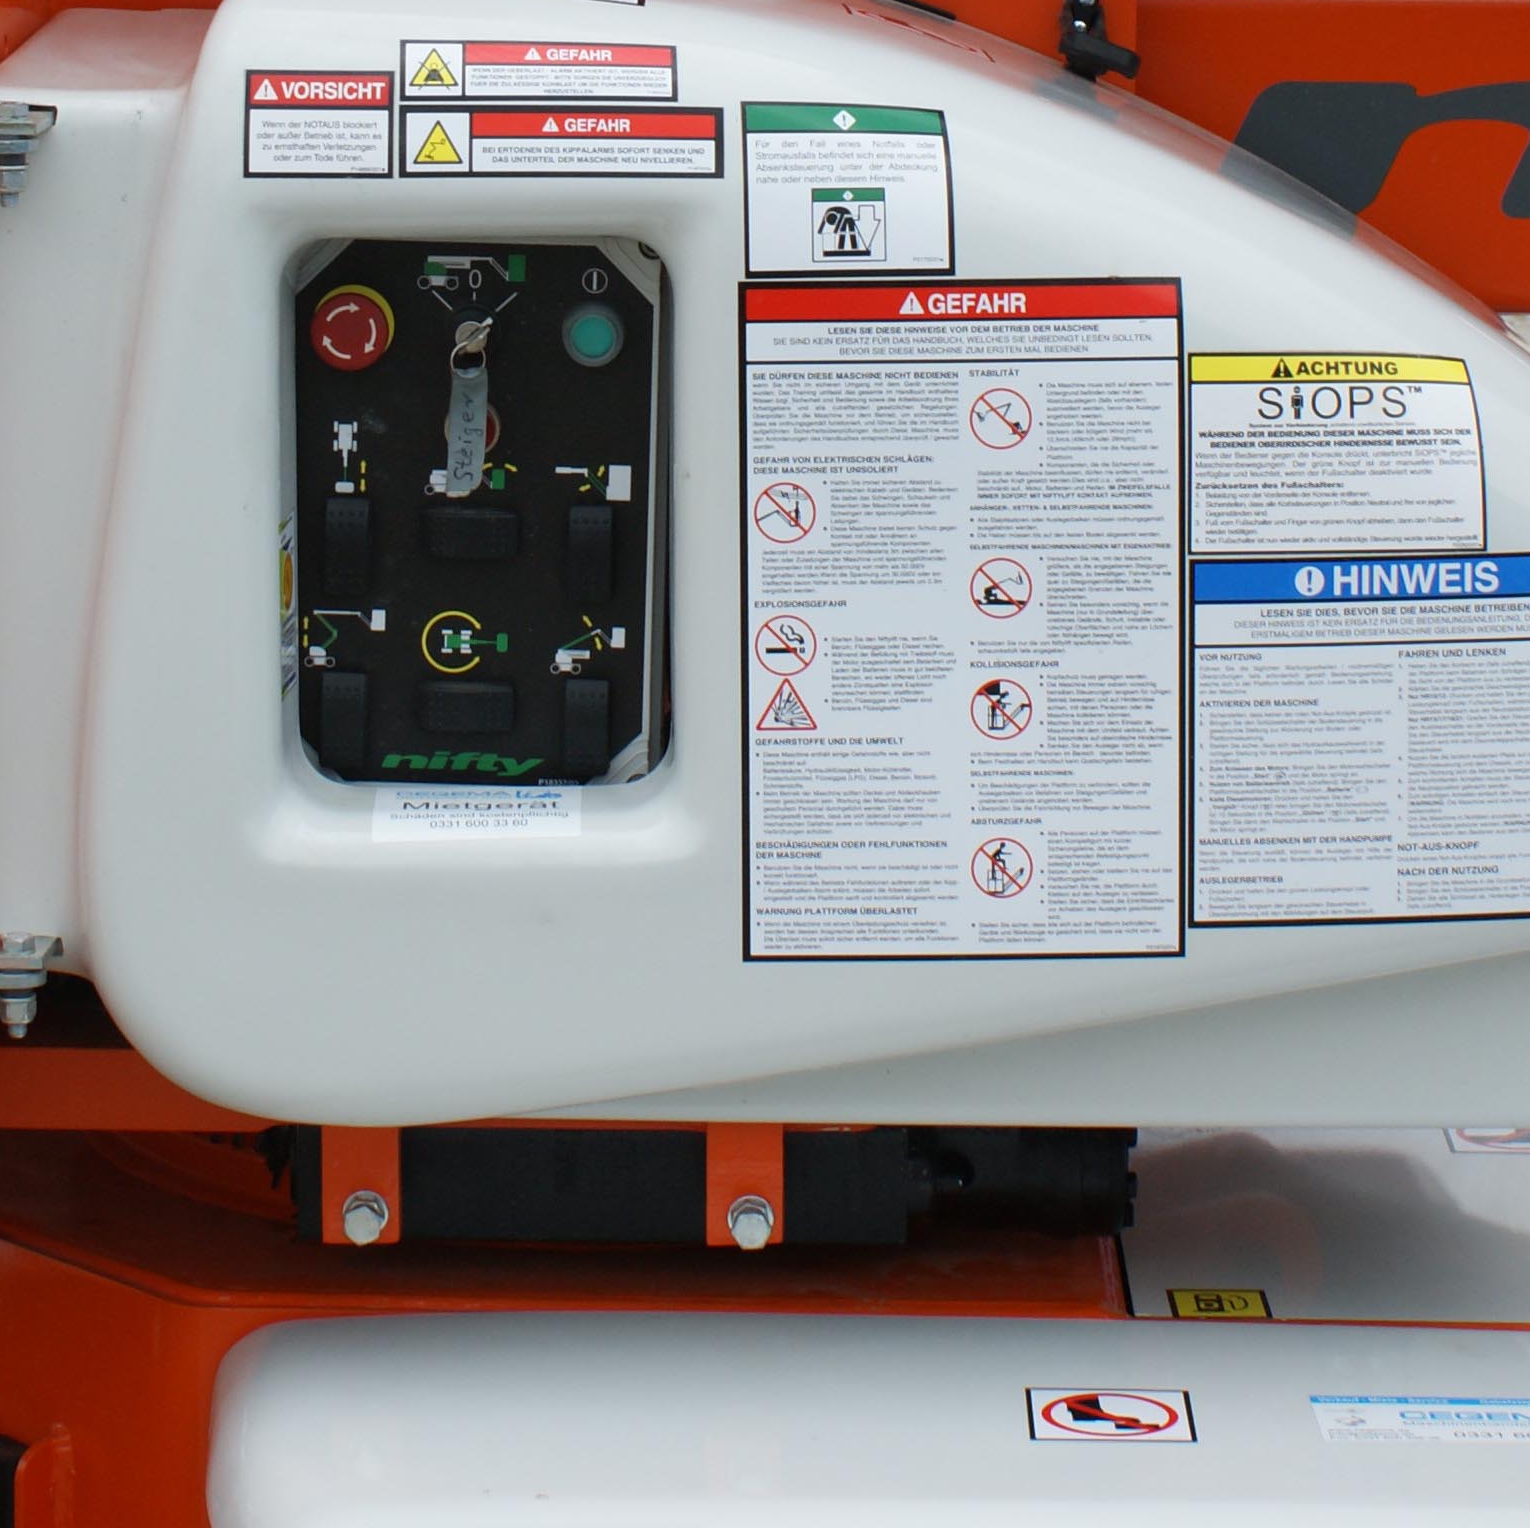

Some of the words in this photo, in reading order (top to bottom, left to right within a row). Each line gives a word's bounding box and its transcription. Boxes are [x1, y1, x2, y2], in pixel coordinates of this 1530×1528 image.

[546, 48, 612, 62] GEFAHR
[280, 81, 386, 100] VORSICHT
[261, 120, 286, 129] Wenn
[288, 120, 301, 129] der
[304, 120, 340, 129] NOTAUS
[343, 120, 377, 129] blockiert
[564, 118, 630, 132] GEFAHR
[257, 131, 274, 140] oder
[277, 131, 301, 140] außer
[304, 131, 333, 140] Betrieb
[336, 132, 347, 141] ist,
[350, 131, 370, 140] kann
[274, 142, 320, 151] ernsthaften
[323, 142, 376, 152] Verletzungen
[482, 146, 496, 154] BEI
[496, 146, 542, 154] ERTOENEN
[543, 146, 560, 154] DES
[561, 147, 615, 155] KIPPALARMS
[616, 147, 649, 155] SOFORT
[651, 147, 685, 155] SENKEN
[686, 147, 705, 155] UND
[273, 154, 291, 162] oder
[315, 154, 333, 162] Tode
[336, 154, 364, 162] führen.
[510, 156, 555, 164] UNTERTEIL
[557, 156, 575, 164] DER
[576, 156, 619, 164] MASCHINE
[620, 156, 638, 164] NEU
[639, 156, 694, 165] NIVELLIEREN.
[927, 292, 1027, 315] GEFAHR
[828, 326, 857, 335] LESEN
[858, 326, 873, 334] SIE
[874, 326, 901, 334] DIESE
[903, 325, 947, 334] HINWEISE
[949, 325, 968, 334] VOR
[970, 325, 990, 333] DEM
[991, 325, 1030, 333] BETRIEB
[1032, 324, 1051, 333] DER
[1052, 324, 1099, 333] MASCHINE
[968, 369, 1019, 377] STABILITÄT
[1296, 361, 1398, 375] ACHTUNG
[752, 372, 766, 380] SIE
[768, 372, 805, 380] DÜRFEN
[806, 371, 833, 380] DIESE
[835, 371, 882, 380] MASCHINE
[884, 371, 910, 380] NICHT
[912, 371, 959, 380] BEDIENEN
[453, 391, 483, 481] Steiger
[753, 456, 790, 464] GEFAHR
[791, 456, 811, 464] VON
[812, 456, 881, 464] ELEKTRISCHEN
[1333, 561, 1499, 596] HINWEIS
[754, 600, 847, 608] EXPLOSIONSGEFAHR
[1260, 608, 1294, 617] LESEN
[1295, 608, 1312, 617] SIE
[1342, 606, 1378, 616] BEVOR
[1381, 606, 1397, 615] SIE
[1399, 605, 1416, 614] DIE
[1418, 604, 1471, 614] MASCHINE
[1473, 603, 1530, 613] BETREIBEN.
[1199, 653, 1218, 662] VOR
[1219, 653, 1262, 661] NUTZUNG
[1397, 649, 1439, 658] FAHREN
[1441, 648, 1463, 657] UND
[1465, 648, 1507, 657] LENKEN
[970, 660, 1059, 668] KOLLISIONSGEFAHR
[1199, 699, 1251, 708] AKTIVIEREN
[1252, 699, 1271, 707] DER
[1273, 698, 1319, 707] MASCHINE
[755, 737, 825, 745] GEFAHRSTOFFE
[827, 737, 847, 745] UND
[848, 737, 863, 745] DIE
[865, 737, 904, 745] UMWELT
[381, 750, 546, 777] nifty
[402, 801, 559, 811] Mietgerät
[430, 820, 460, 829] 0331
[465, 820, 489, 828] 600
[493, 819, 509, 827] 33
[512, 819, 528, 827] 60
[755, 840, 839, 849] BESCHÄDIGUNGEN
[840, 840, 866, 848] ODER
[867, 840, 948, 848] FEHLFUNKTIONEN
[1397, 867, 1426, 876] NACH
[1427, 866, 1449, 876] DER
[1450, 865, 1500, 875] NUTZUNG
[756, 907, 802, 915] WARNUNG
[803, 907, 858, 915] PLATTFORM
[859, 907, 918, 915] ÜBERLASTET
